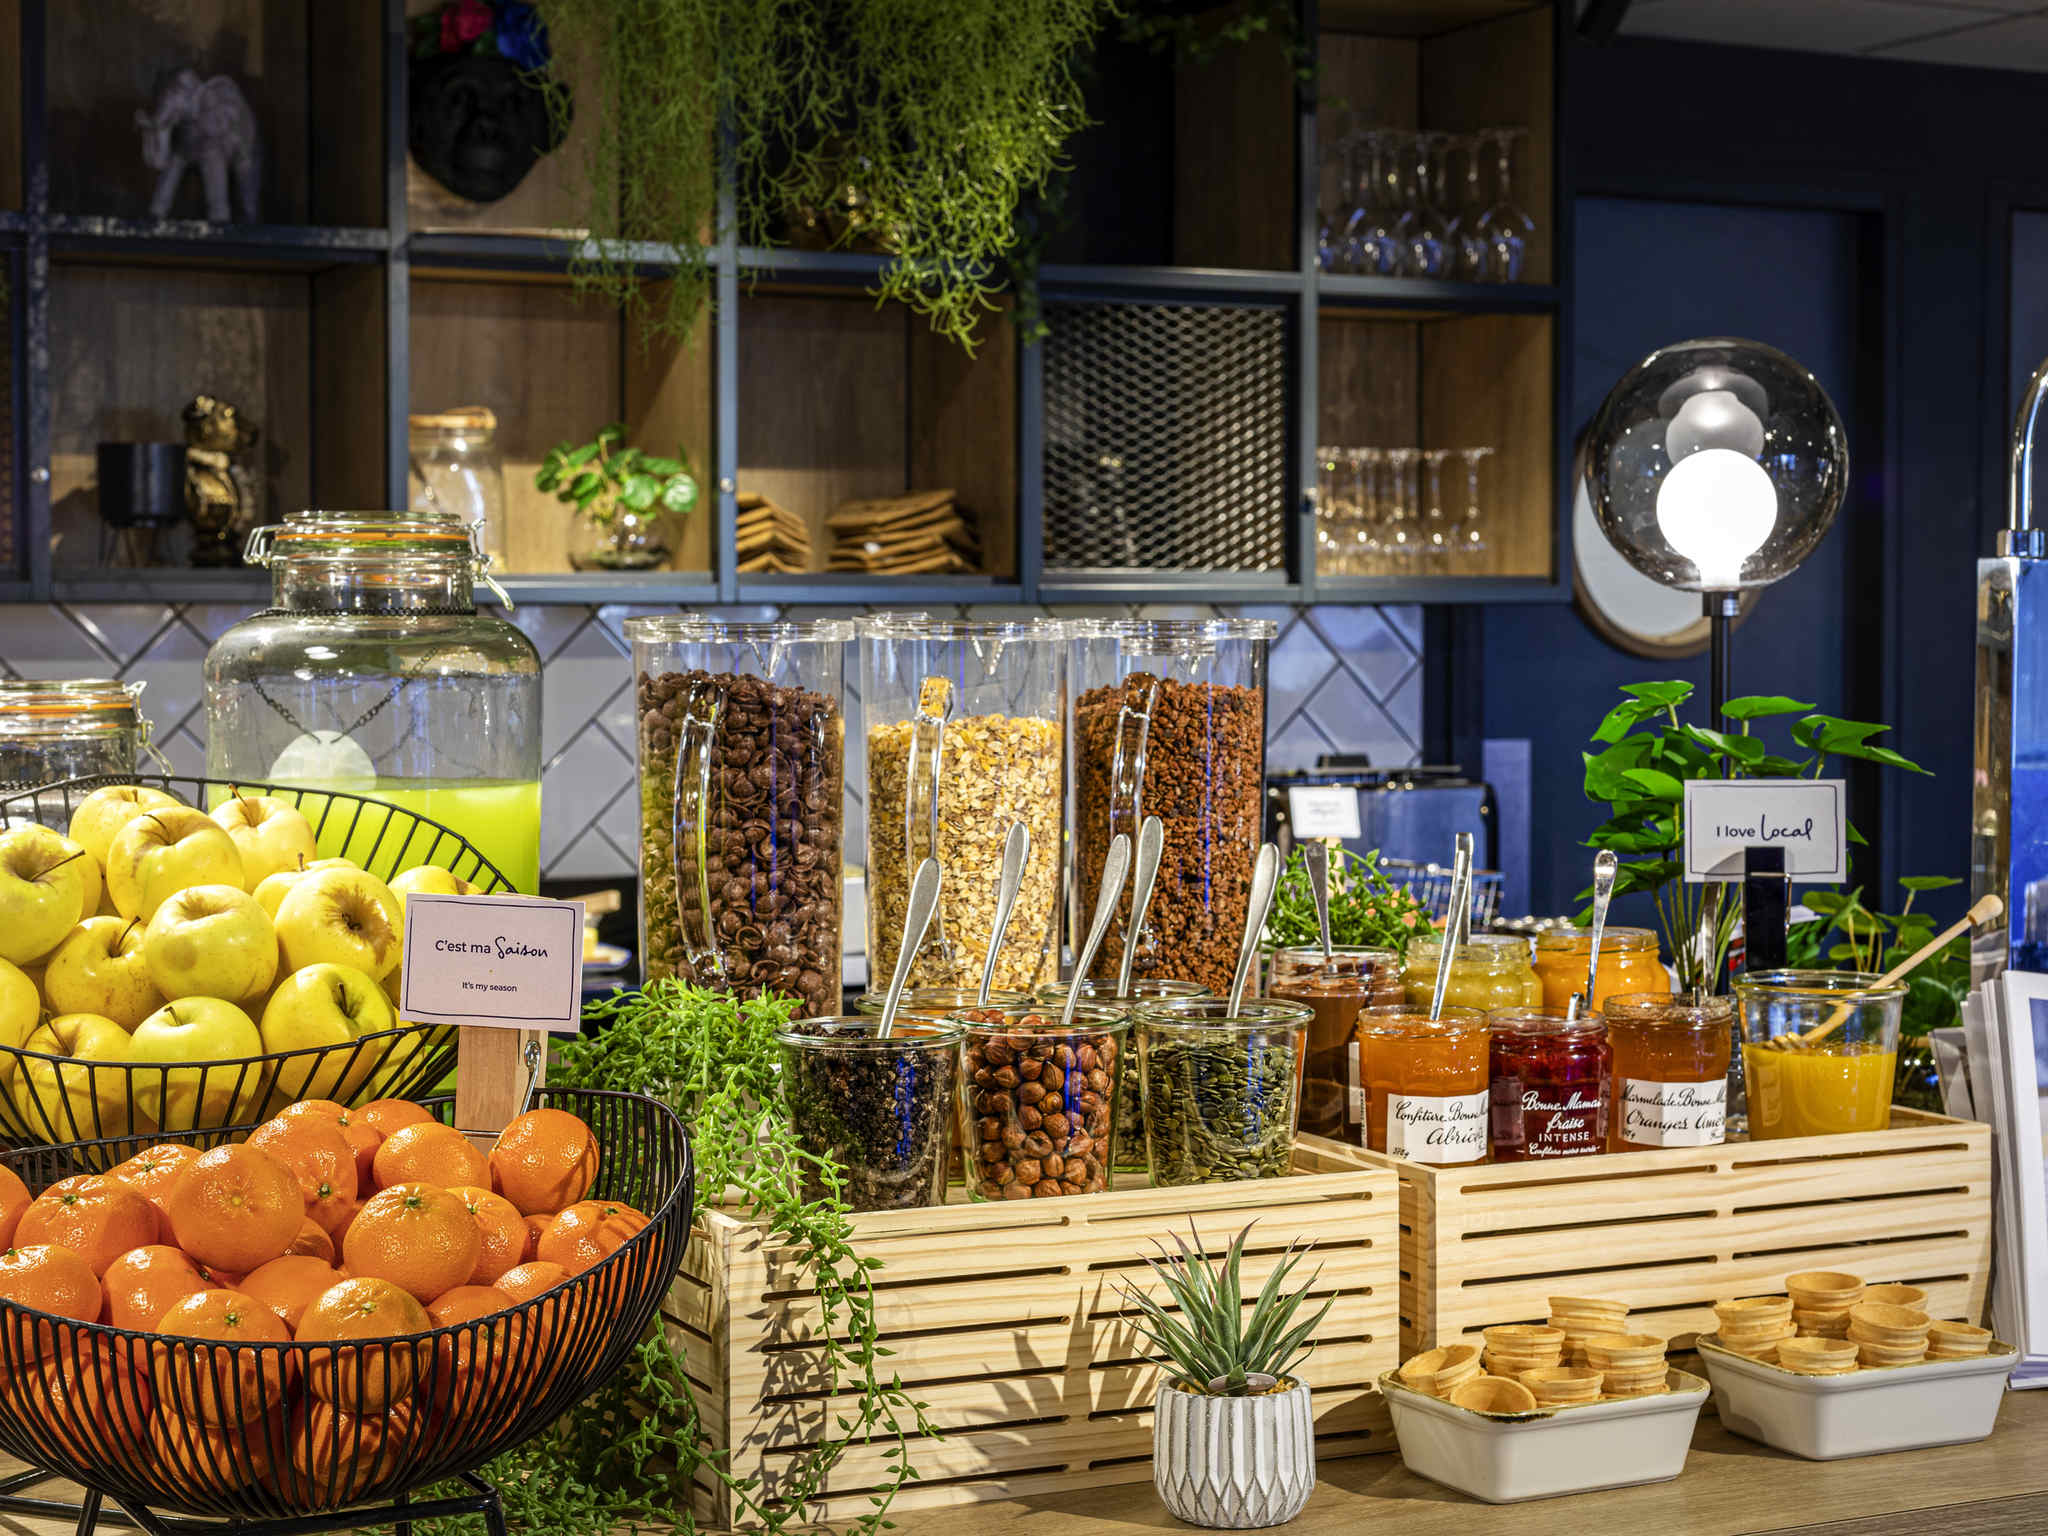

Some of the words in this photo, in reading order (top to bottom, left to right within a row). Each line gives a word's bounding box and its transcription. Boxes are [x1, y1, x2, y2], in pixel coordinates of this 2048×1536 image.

[1716, 826, 1720, 837] I
[1725, 825, 1756, 837] love
[1761, 814, 1813, 841] Local
[435, 940, 467, 953] C'est
[470, 943, 491, 953] ma
[495, 936, 548, 959] Saison
[462, 982, 474, 990] It's
[475, 984, 488, 992] my
[1521, 1090, 1561, 1111] Bonne
[1395, 1100, 1445, 1126] Confiture
[1626, 1109, 1688, 1133] Oranges
[1539, 1131, 1590, 1143] INTENSE
